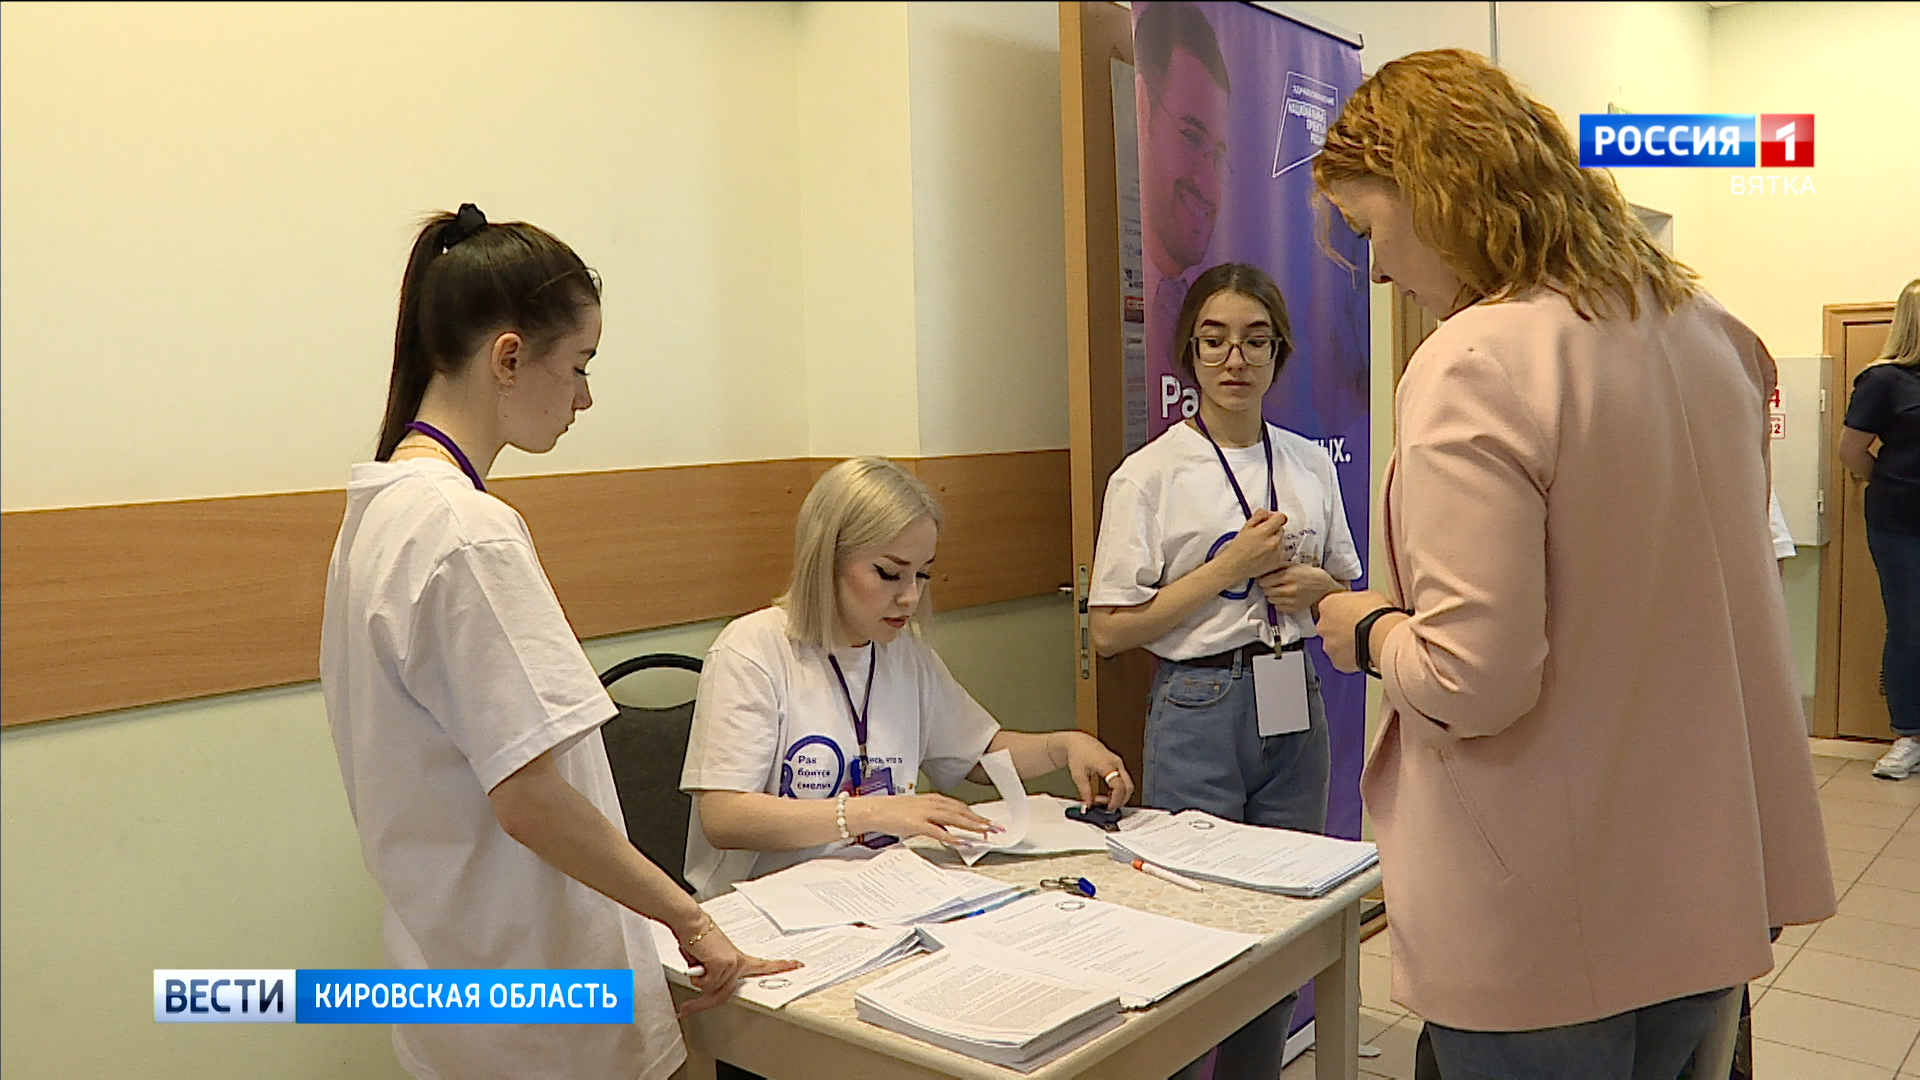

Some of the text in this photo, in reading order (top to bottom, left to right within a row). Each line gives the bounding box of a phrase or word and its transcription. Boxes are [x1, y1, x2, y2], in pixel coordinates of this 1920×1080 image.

[1161, 374, 1199, 418] Ра
[798, 755, 817, 764] Рак
[797, 767, 831, 777] боится
